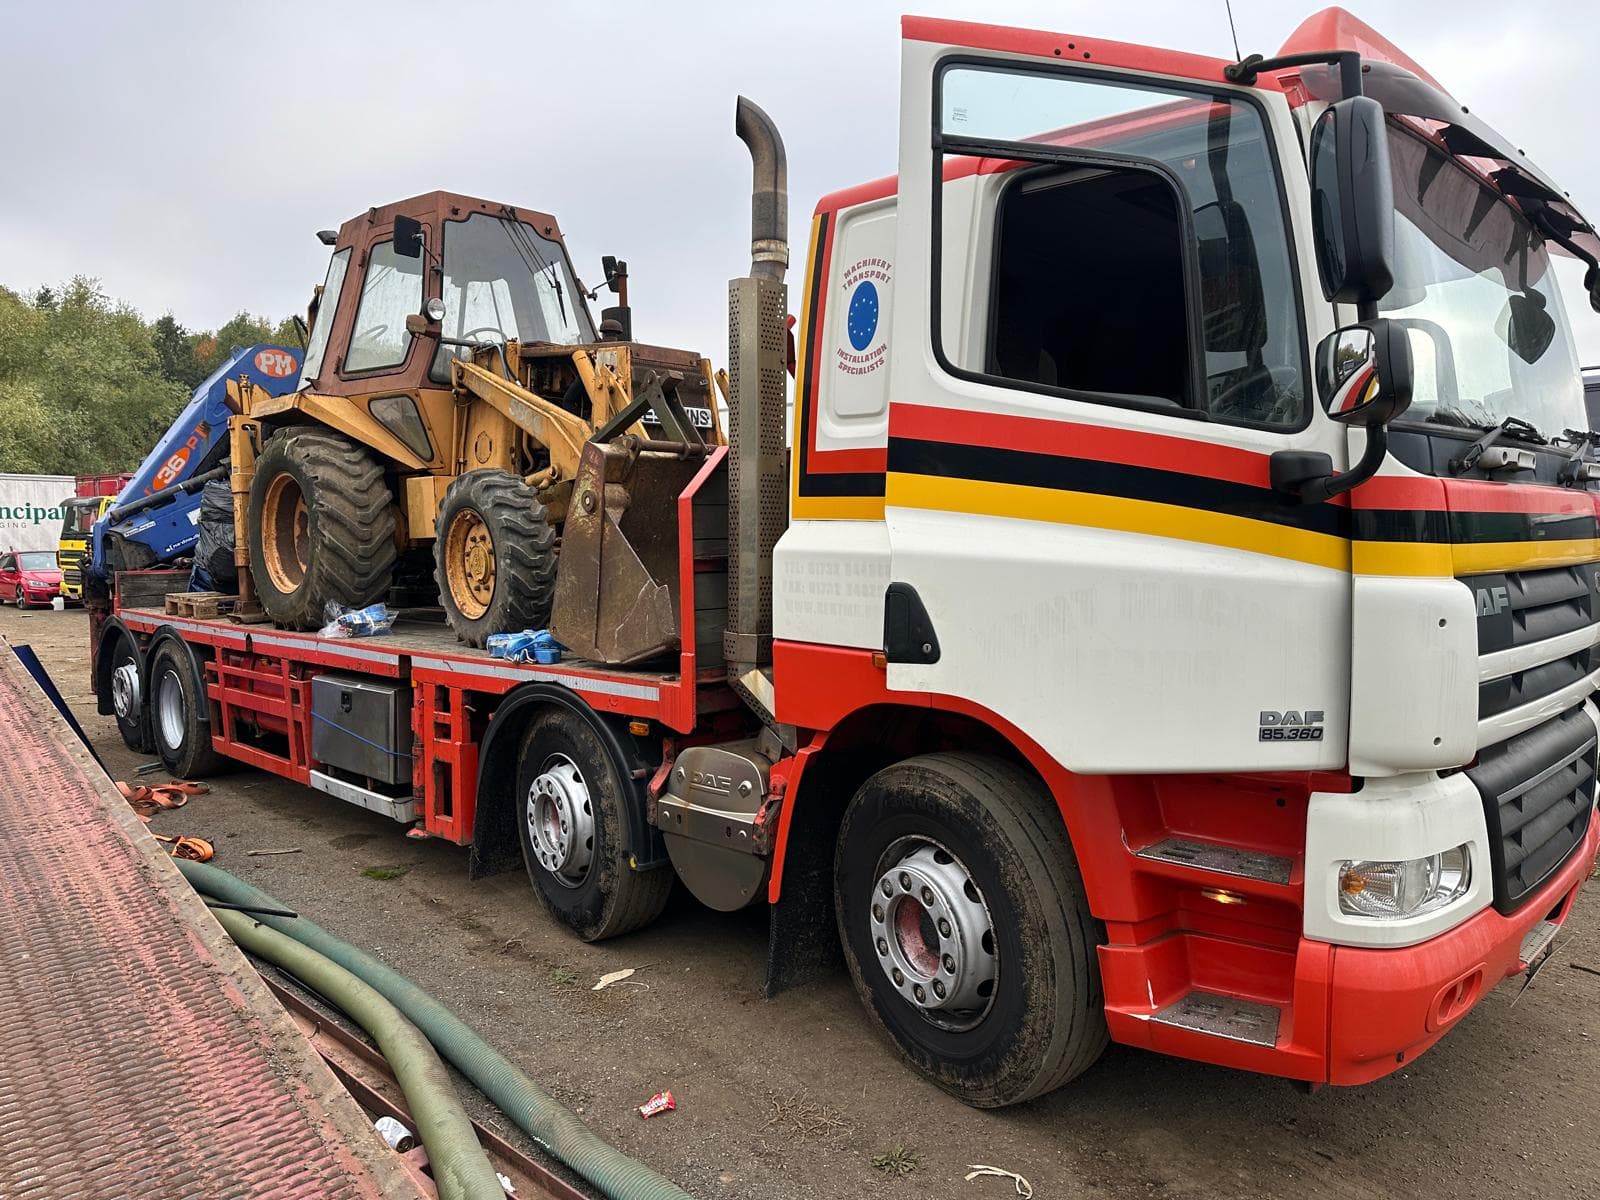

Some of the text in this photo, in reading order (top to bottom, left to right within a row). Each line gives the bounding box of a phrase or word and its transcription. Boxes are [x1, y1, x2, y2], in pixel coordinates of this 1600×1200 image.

[844, 258, 892, 279] MACHINERY
[842, 270, 892, 290] TRANSPORT
[259, 352, 292, 374] PM
[837, 343, 887, 363] INSTALLATION
[838, 357, 885, 375] SPECIALISTS
[157, 454, 186, 484] 36
[1260, 710, 1325, 726] DAF
[1260, 727, 1324, 740] 85.360
[690, 771, 732, 790] DAF
